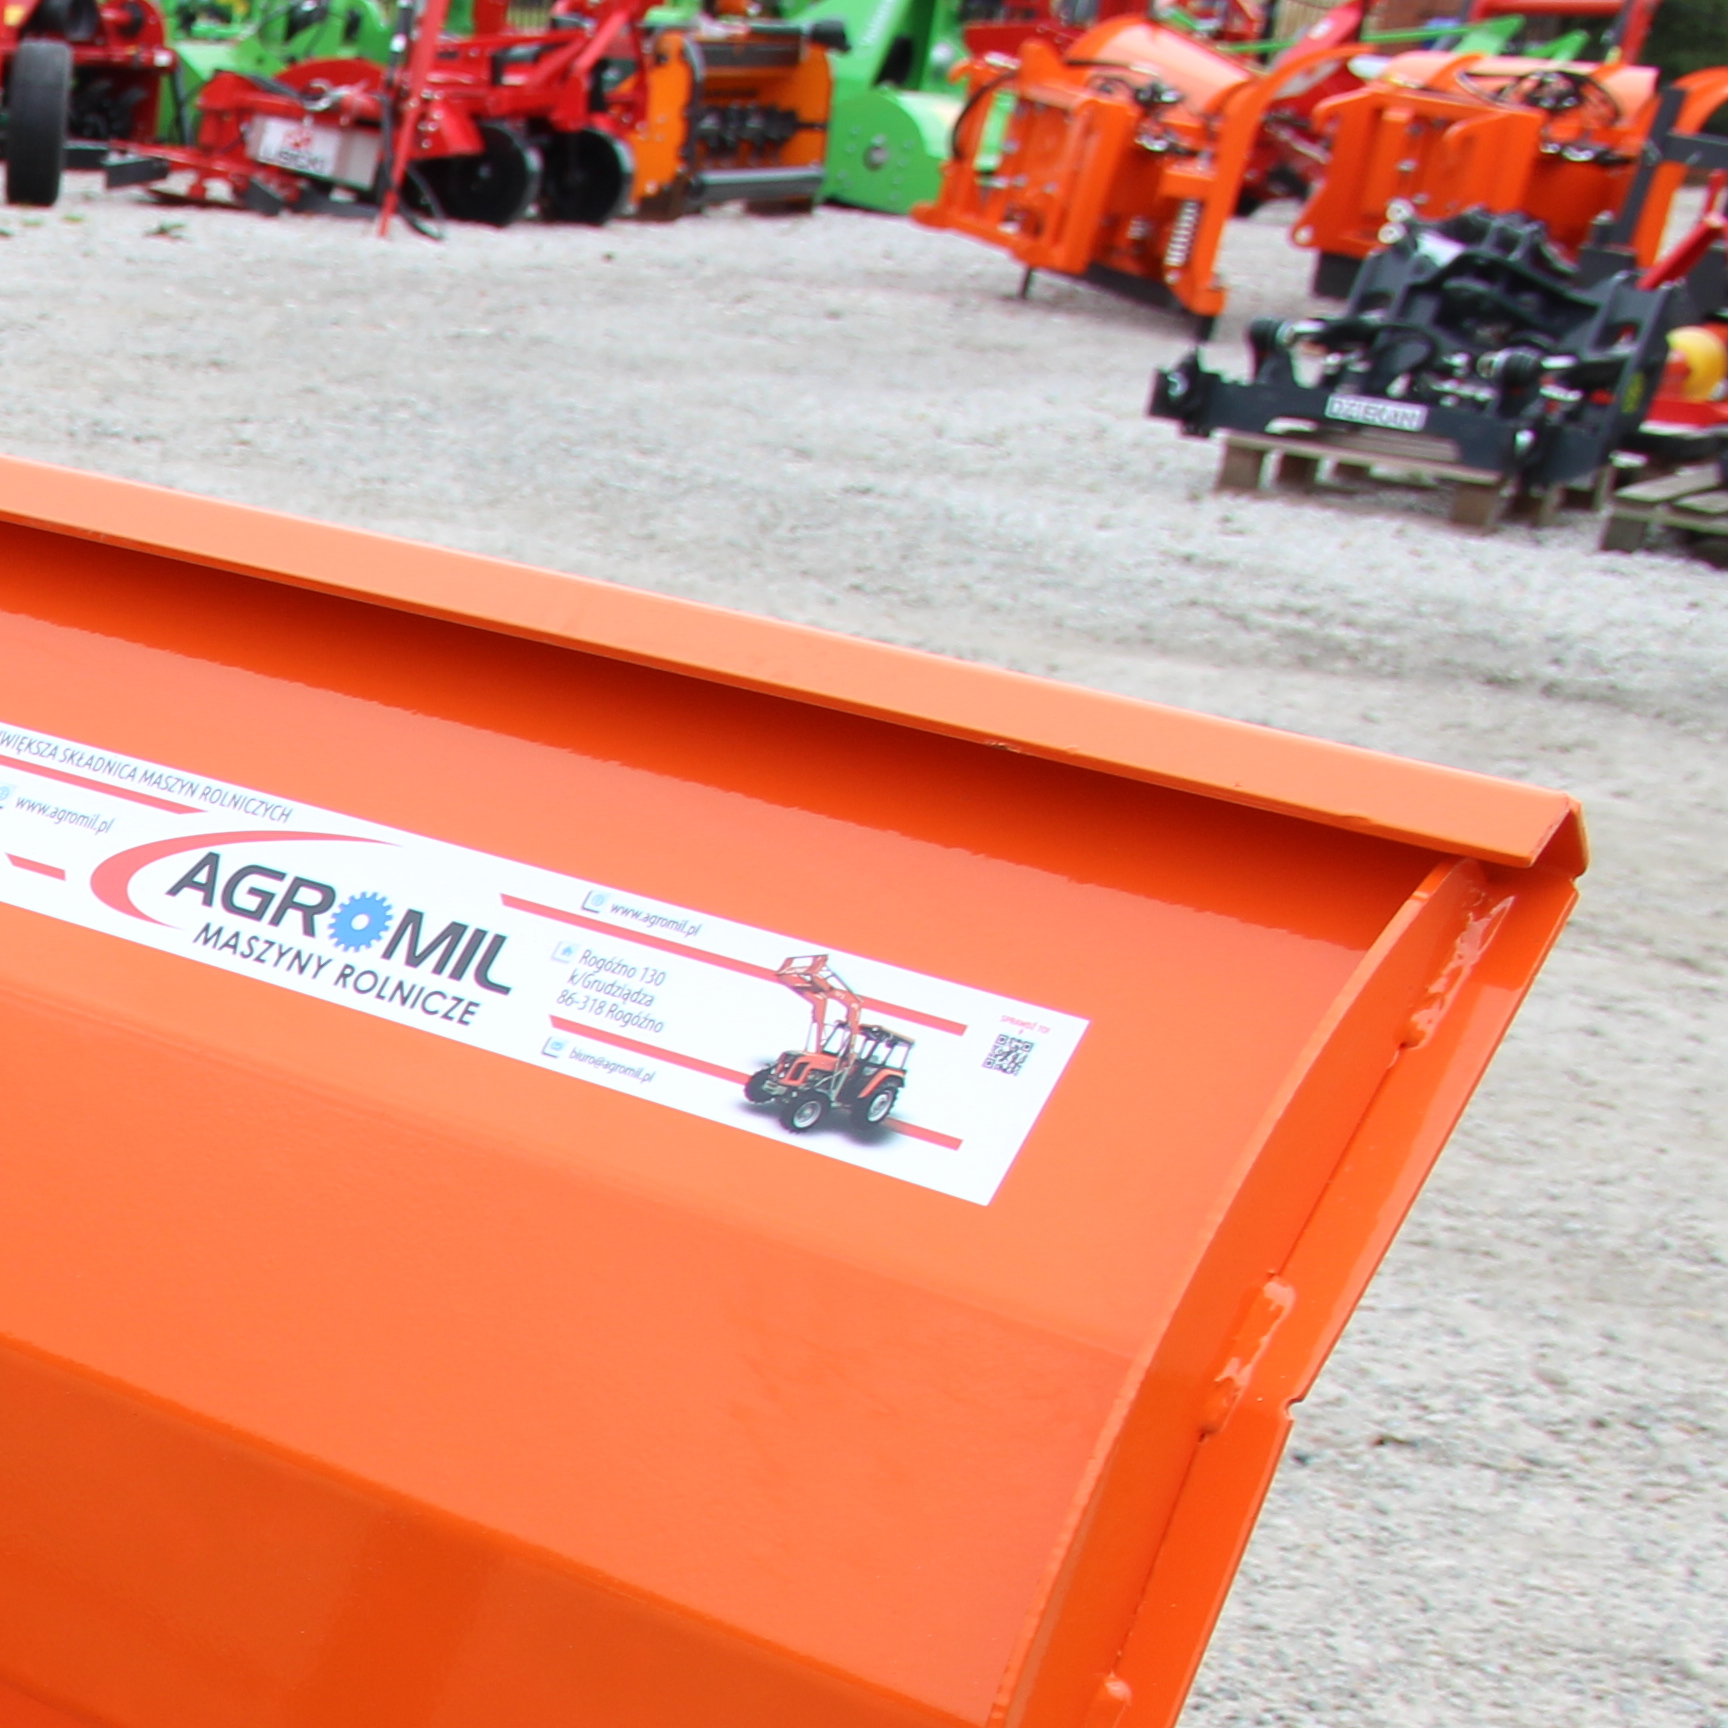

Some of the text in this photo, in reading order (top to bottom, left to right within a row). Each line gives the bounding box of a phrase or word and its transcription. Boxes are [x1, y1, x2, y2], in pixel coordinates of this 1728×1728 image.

[58, 747, 138, 781] SKŁADNICA
[138, 769, 200, 798] MASZYN
[199, 785, 294, 824] ROLNICZYCH
[15, 796, 115, 835] www.agromil.pl
[610, 903, 702, 938] www.agromil.pl
[192, 922, 482, 1027] MASZYNY ROLNICZE
[567, 967, 655, 1007] k/Grudziądza
[579, 948, 667, 987] Rogóźno 130
[556, 989, 665, 1034] 86-318 Rogóźno
[569, 1047, 657, 1084] biuro@agromil.pl
